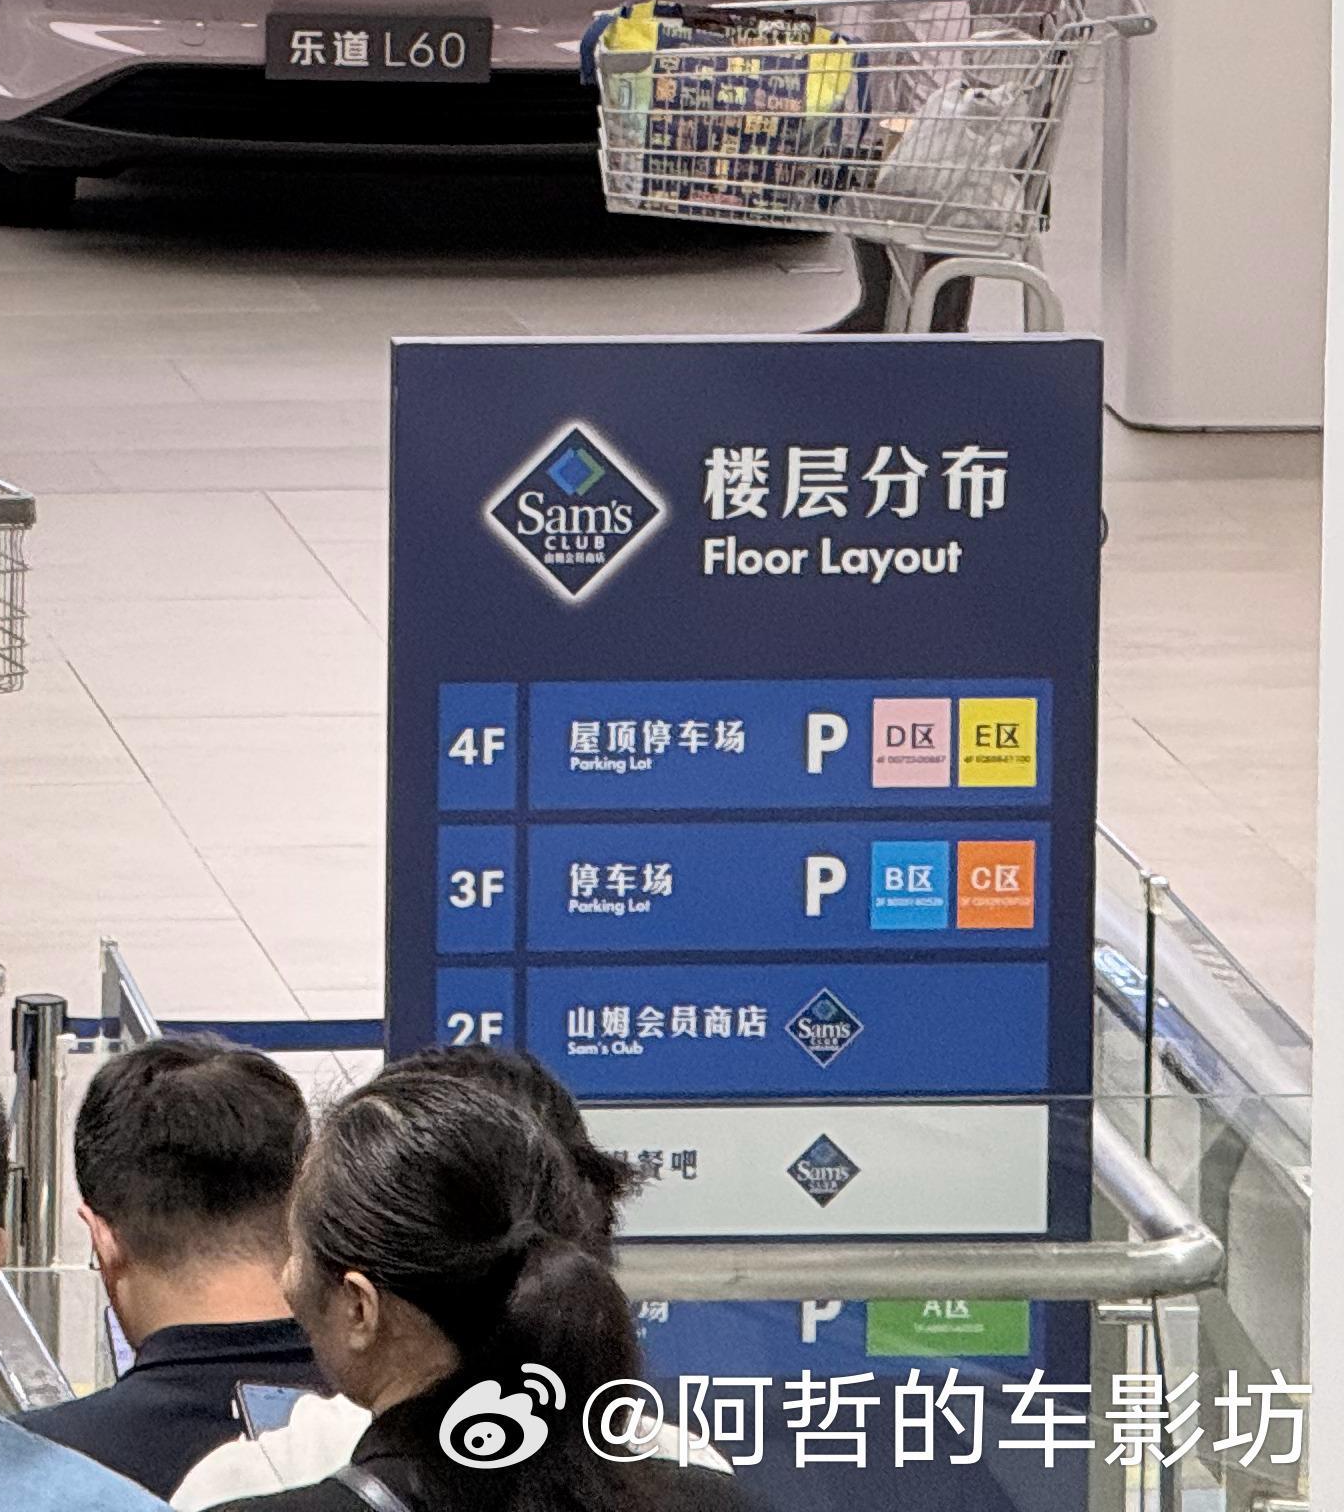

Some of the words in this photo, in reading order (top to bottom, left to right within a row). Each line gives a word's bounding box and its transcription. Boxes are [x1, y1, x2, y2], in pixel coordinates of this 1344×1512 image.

[702, 444, 1009, 521] 楼层分布
[517, 491, 633, 536] Sam's
[544, 535, 606, 551] CLUB
[703, 538, 808, 576] Floor
[821, 538, 963, 583] Layout
[448, 726, 506, 766] 4F
[569, 719, 746, 755] 屋顶停车场
[806, 712, 849, 774] P
[885, 722, 936, 750] D区
[975, 722, 1020, 750] E区
[569, 756, 626, 774] Parking
[629, 756, 652, 771] Lot
[448, 869, 505, 908] 3F
[569, 862, 673, 898] 停车场
[804, 855, 848, 917] P
[884, 864, 934, 893] B区
[970, 864, 1021, 893] C区
[568, 898, 625, 917] Parking
[628, 898, 651, 913] Lot
[447, 1012, 503, 1048] 2F
[567, 1004, 769, 1039] 山姆会员商店
[797, 1017, 851, 1039] Sam's
[567, 1040, 609, 1055] Sam's
[611, 1040, 644, 1055] Club
